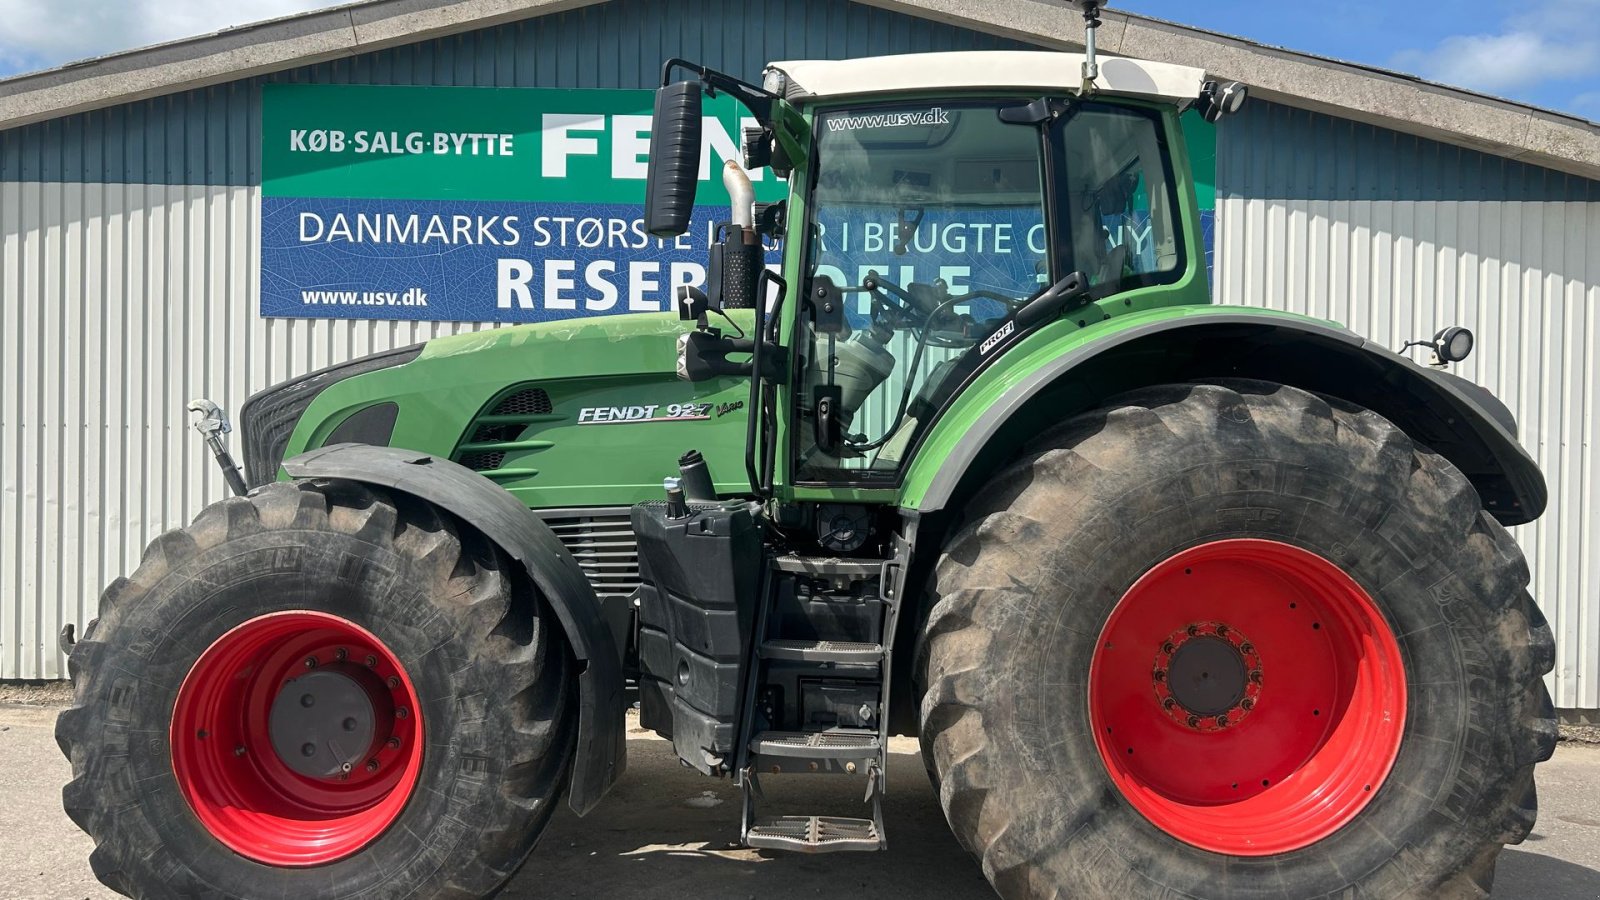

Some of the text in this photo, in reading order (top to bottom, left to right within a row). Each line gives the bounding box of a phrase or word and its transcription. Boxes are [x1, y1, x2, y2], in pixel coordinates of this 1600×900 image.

[826, 107, 950, 132] www.usv.dk
[299, 212, 520, 246] DANMARKS
[301, 288, 428, 306] www.usv.dk
[981, 322, 1013, 353] PROFI
[578, 404, 659, 422] FENDT
[665, 402, 713, 420] 927
